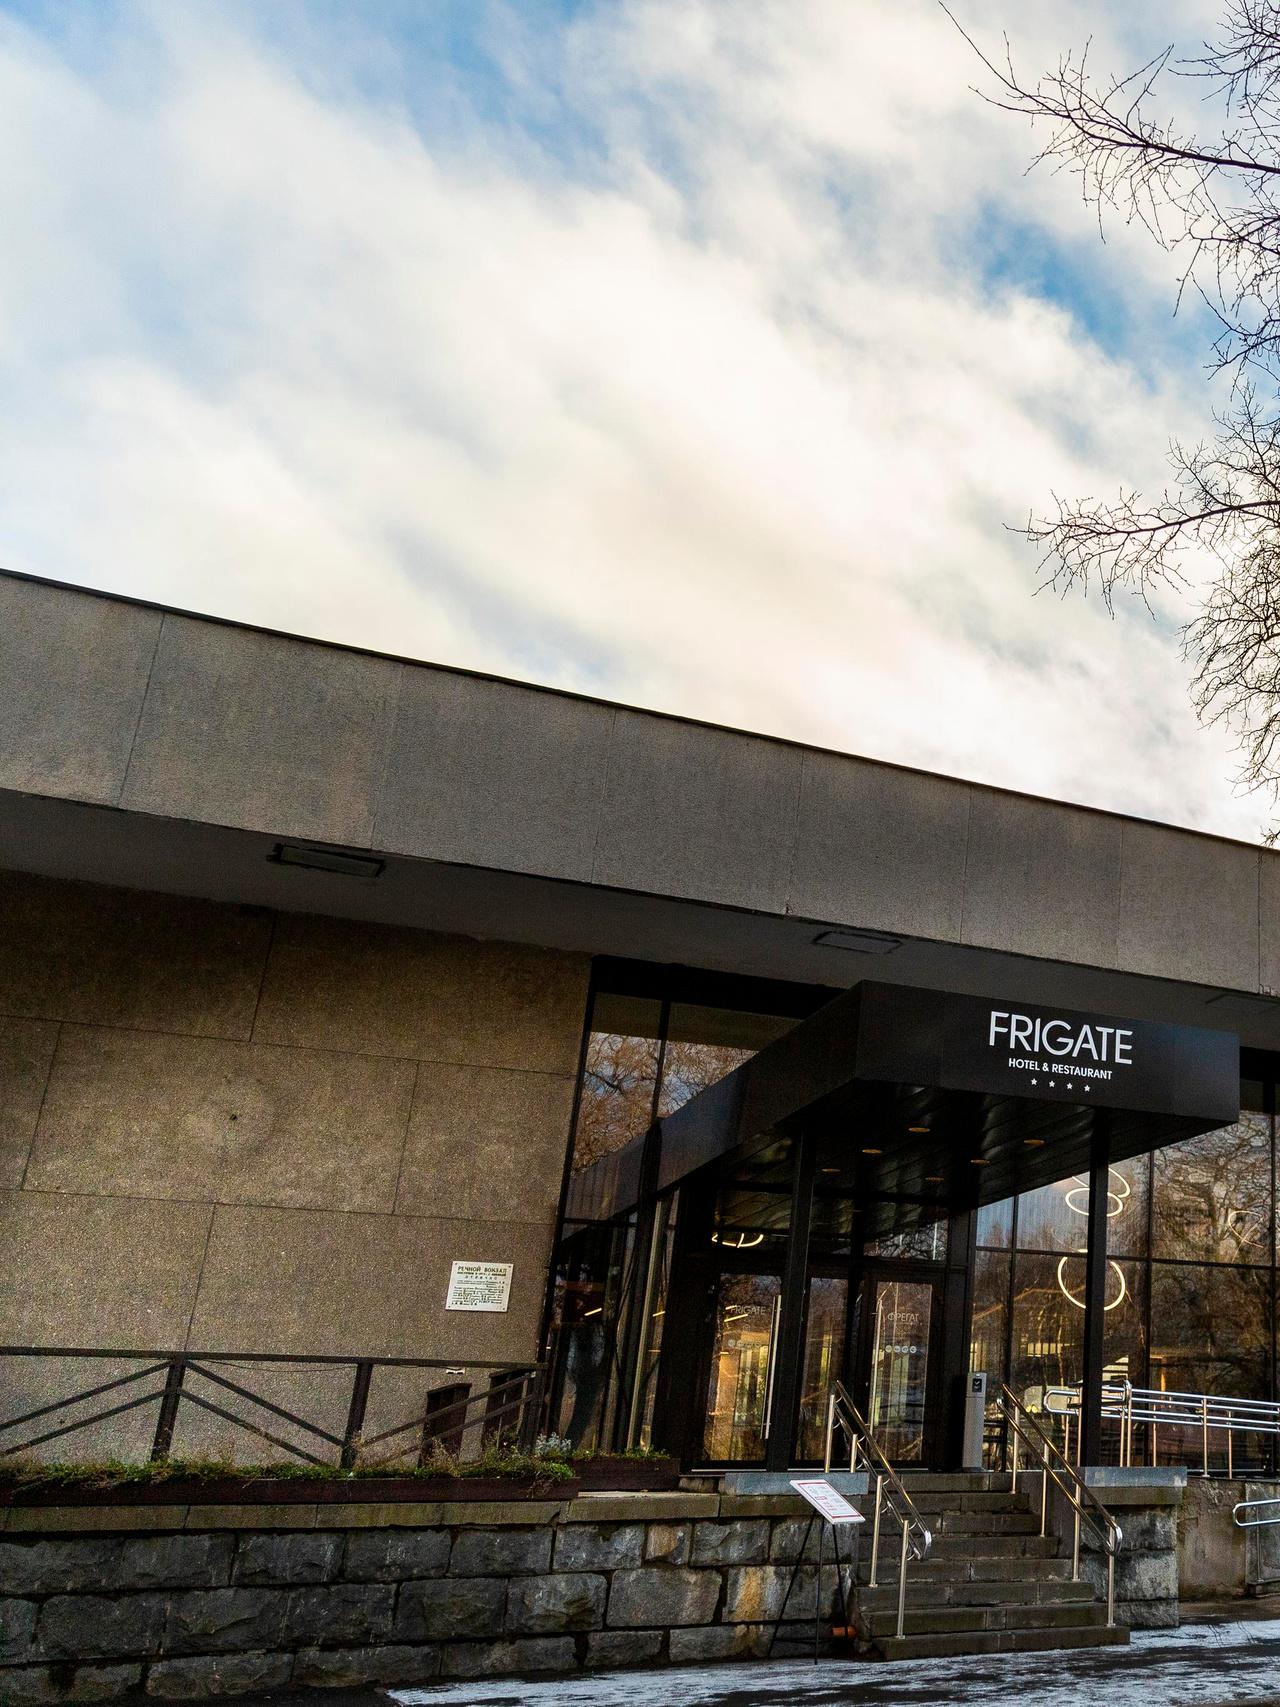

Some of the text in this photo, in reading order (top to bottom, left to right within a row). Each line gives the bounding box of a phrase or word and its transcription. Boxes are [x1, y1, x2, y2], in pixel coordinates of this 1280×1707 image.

[989, 1011, 1133, 1065] FRIGATE
[1008, 1057, 1113, 1081] HOTEL & RESTAURANT
[730, 1305, 766, 1316] FRIGATE
[887, 1312, 920, 1322] ФРЕГАТ
